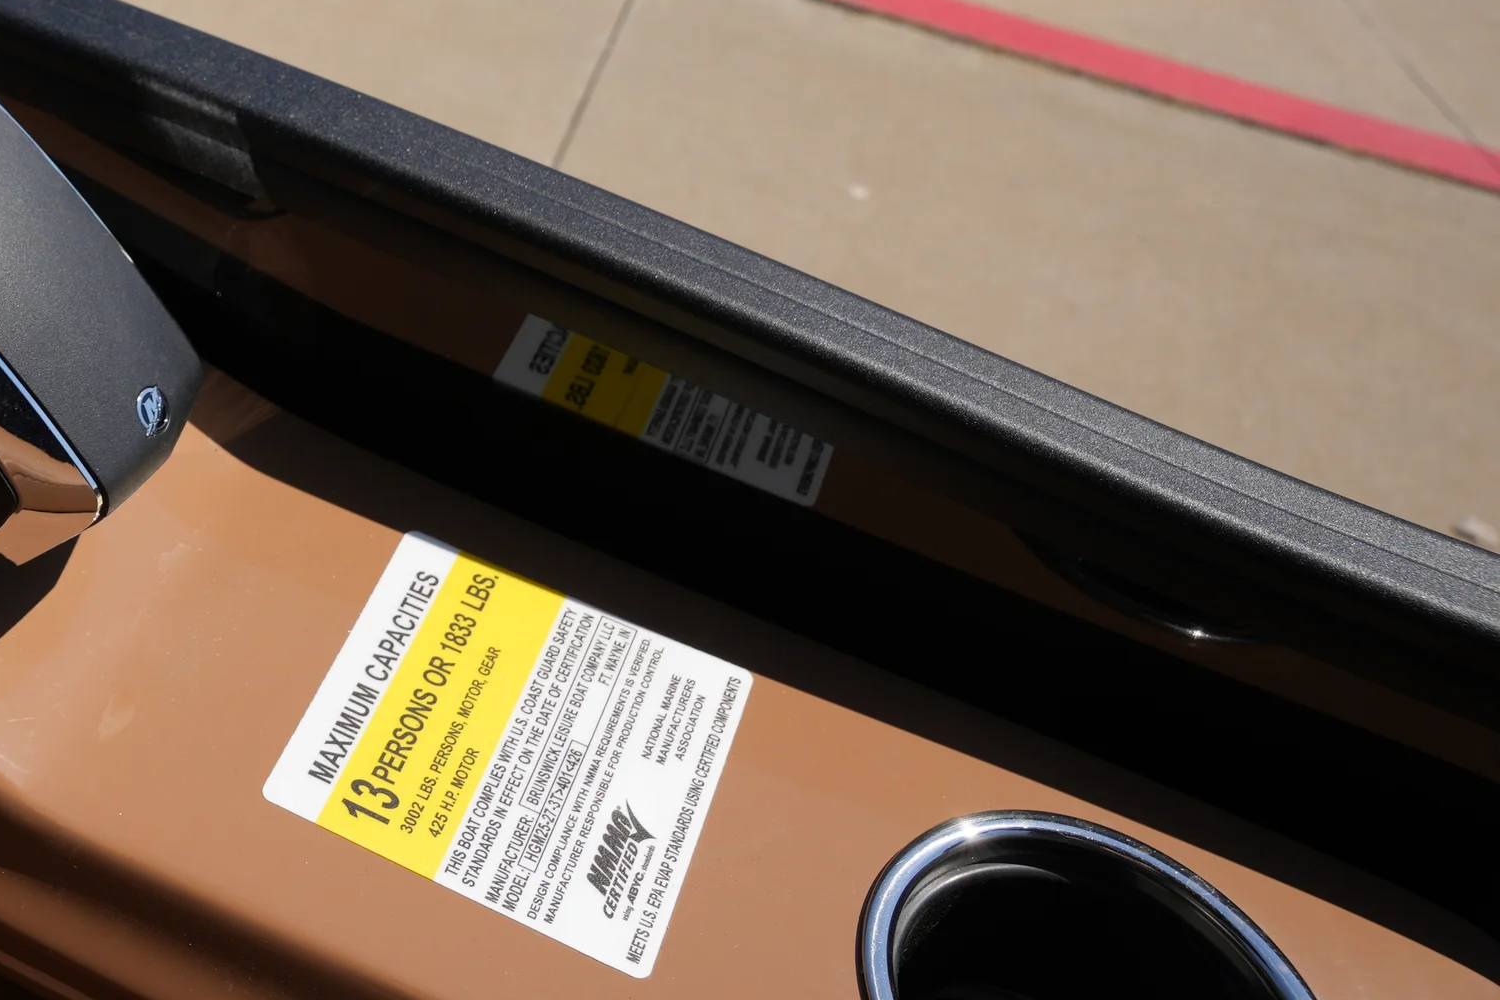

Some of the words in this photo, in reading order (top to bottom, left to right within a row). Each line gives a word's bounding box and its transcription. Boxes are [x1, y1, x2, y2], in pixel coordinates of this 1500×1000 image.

[459, 567, 499, 612] LBS.
[437, 611, 478, 656] 1833
[550, 606, 577, 645] SAFETY
[617, 627, 632, 639] IN
[534, 643, 561, 680] GUARD
[553, 611, 595, 683] CERTIFICATION
[603, 637, 629, 673] WAYNE,
[627, 635, 651, 677] VERIFIED.
[307, 681, 380, 785] MAXIMUM
[362, 568, 441, 683] CAPACITIES
[420, 653, 455, 689] OR
[546, 681, 563, 699] OF
[597, 670, 613, 686] FT.
[623, 676, 634, 687] IS
[518, 678, 545, 715] COAST
[534, 697, 557, 726] DATE
[640, 710, 667, 759] NATIONAL
[659, 673, 681, 711] MARINE
[709, 675, 742, 735] COMPONENTS
[370, 685, 439, 786] PERSONS
[399, 800, 425, 834] 3002
[415, 772, 439, 801] LBS.
[429, 717, 468, 775] PERSONS,
[456, 675, 488, 720] MOTOR,
[476, 645, 501, 677] GEAR
[509, 713, 529, 736] U.S.
[524, 724, 544, 748] THE
[594, 687, 630, 758] REQUIREMENTS
[655, 677, 696, 766] MANUFACTURERS
[673, 693, 706, 761] ASSOCIATION
[449, 746, 480, 789] MOTOR
[484, 812, 534, 904] MANUFACTURER:
[526, 745, 561, 806] BRUNSWICK
[551, 706, 578, 748] LEISURE
[568, 681, 589, 708] BOAT
[579, 638, 608, 683] COMPANY
[598, 621, 615, 640] LLC
[496, 734, 519, 764] WITH
[516, 746, 535, 765] ON
[693, 732, 721, 779] CERTIFIED
[471, 761, 507, 818] COMPLIES
[498, 763, 527, 806] EFFECT
[543, 838, 586, 925] MANUFACTURER
[578, 769, 614, 839] RESPONSIBLE
[606, 748, 622, 769] FOR
[615, 688, 646, 749] PRODUCTION
[639, 643, 664, 689] CONTROL.
[581, 756, 602, 787] NMMA
[337, 774, 403, 831] 13
[439, 787, 460, 812] H.P.
[571, 786, 589, 814] WITH
[683, 776, 705, 807] USING
[426, 811, 449, 839] 425
[492, 805, 509, 820] IN
[501, 867, 531, 912] MODEL:
[523, 747, 583, 863] HGM25-27-3T>401<426
[457, 816, 482, 850] BOAT
[461, 817, 503, 888] STANDARDS
[543, 813, 578, 879] COMPLIANCE
[663, 805, 695, 863] STANDARDS
[444, 848, 468, 878] THIS
[600, 840, 640, 920] CERTIFIED
[653, 860, 675, 889] EVAP
[527, 879, 551, 920] DESIGN
[646, 886, 666, 909] EPA
[638, 906, 659, 930] U.S.
[626, 927, 651, 965] MEETS
